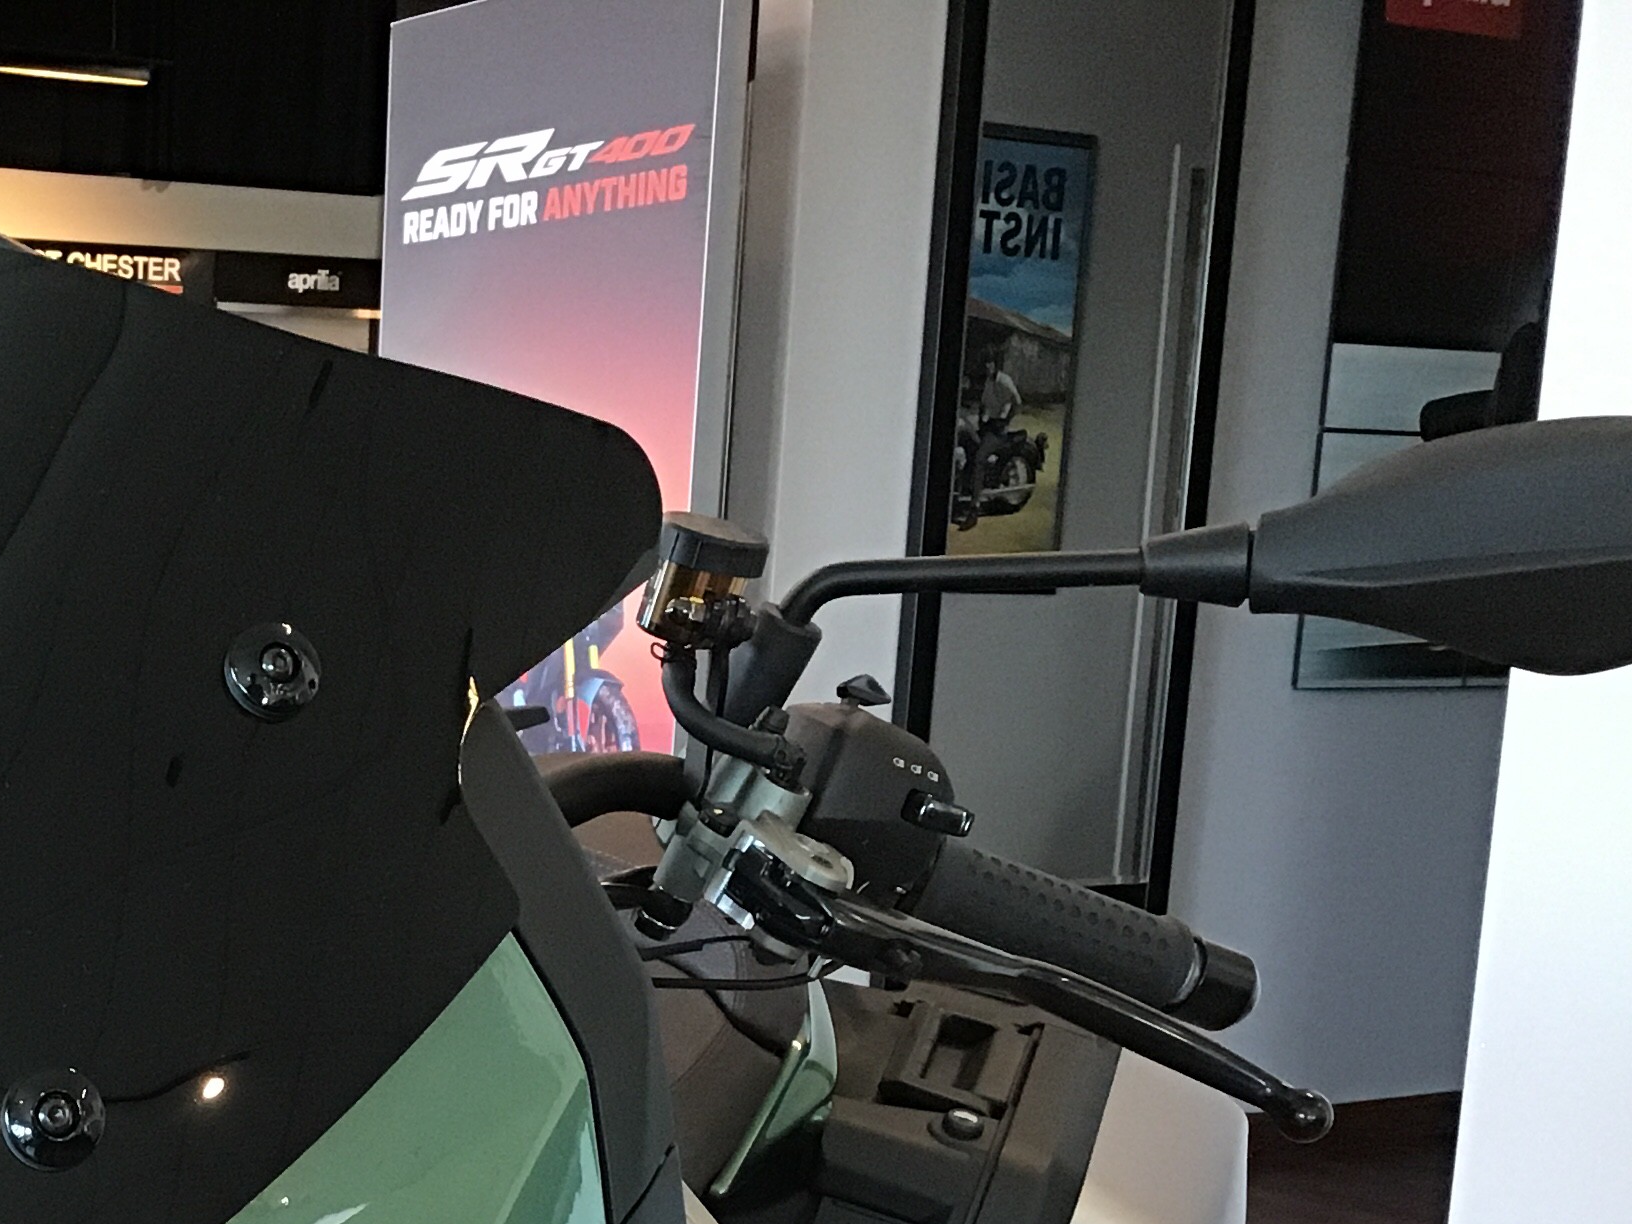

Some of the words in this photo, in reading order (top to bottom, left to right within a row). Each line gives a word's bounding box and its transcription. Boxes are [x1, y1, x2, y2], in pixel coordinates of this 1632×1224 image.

[402, 199, 484, 245] READY
[488, 190, 539, 231] FOR
[542, 164, 688, 222] ANYTHING
[287, 269, 340, 293] aprilia
